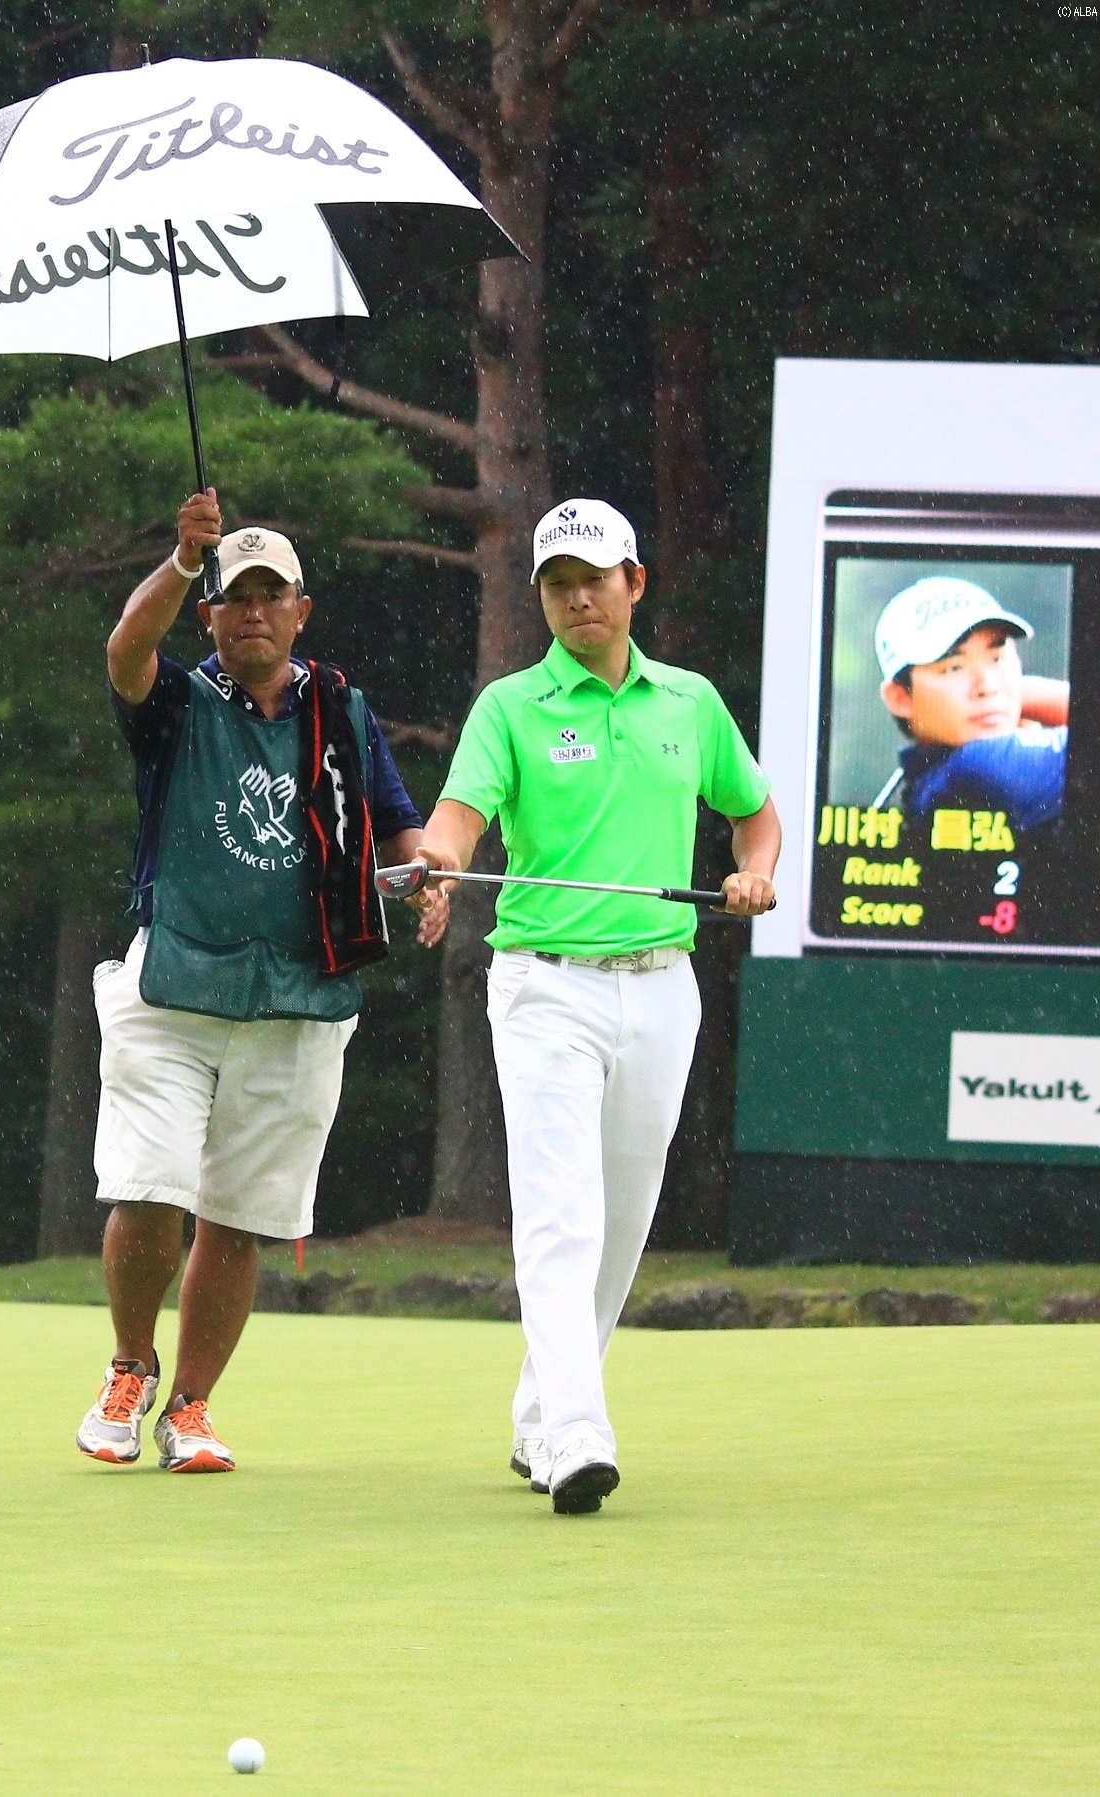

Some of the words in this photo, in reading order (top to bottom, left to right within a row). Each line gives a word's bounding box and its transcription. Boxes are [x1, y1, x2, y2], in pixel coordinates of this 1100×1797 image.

[49, 97, 389, 206] Titleist
[539, 523, 604, 549] SHINHAN
[214, 800, 276, 871] FUJISANKEI
[818, 805, 903, 849] 川村
[842, 856, 922, 887] Rank
[993, 860, 1020, 895] 2
[841, 895, 925, 926] Score
[978, 900, 1019, 935] -8
[959, 1075, 1091, 1102] Yakult
